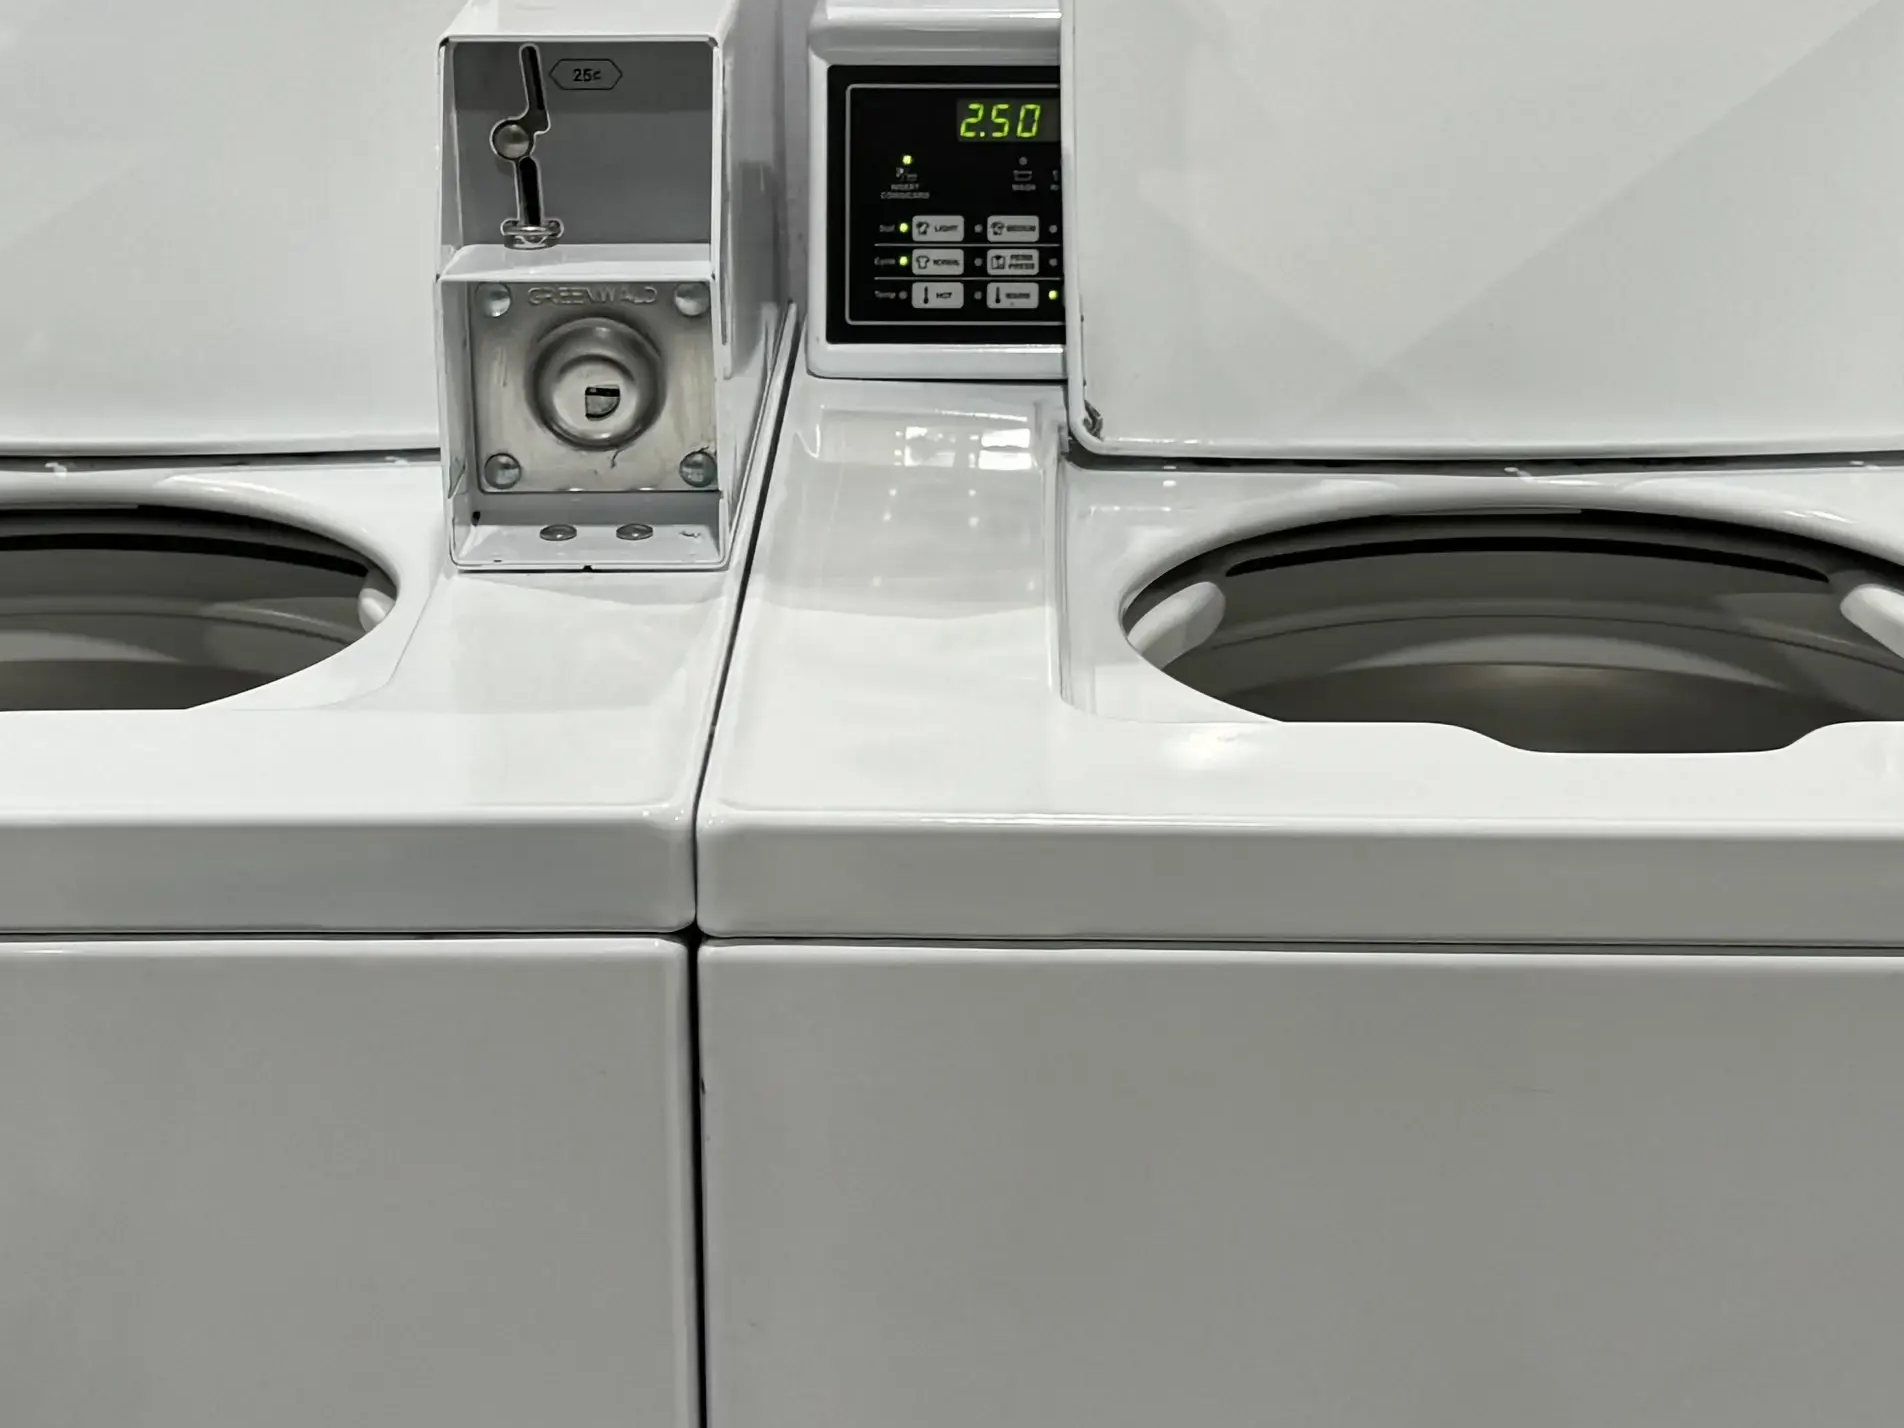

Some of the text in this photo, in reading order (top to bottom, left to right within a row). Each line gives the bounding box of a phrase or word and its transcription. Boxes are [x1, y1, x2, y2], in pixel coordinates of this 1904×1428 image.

[960, 103, 1041, 138] 2.50
[527, 285, 658, 305] GREENWALD
[936, 291, 953, 299] HOT
